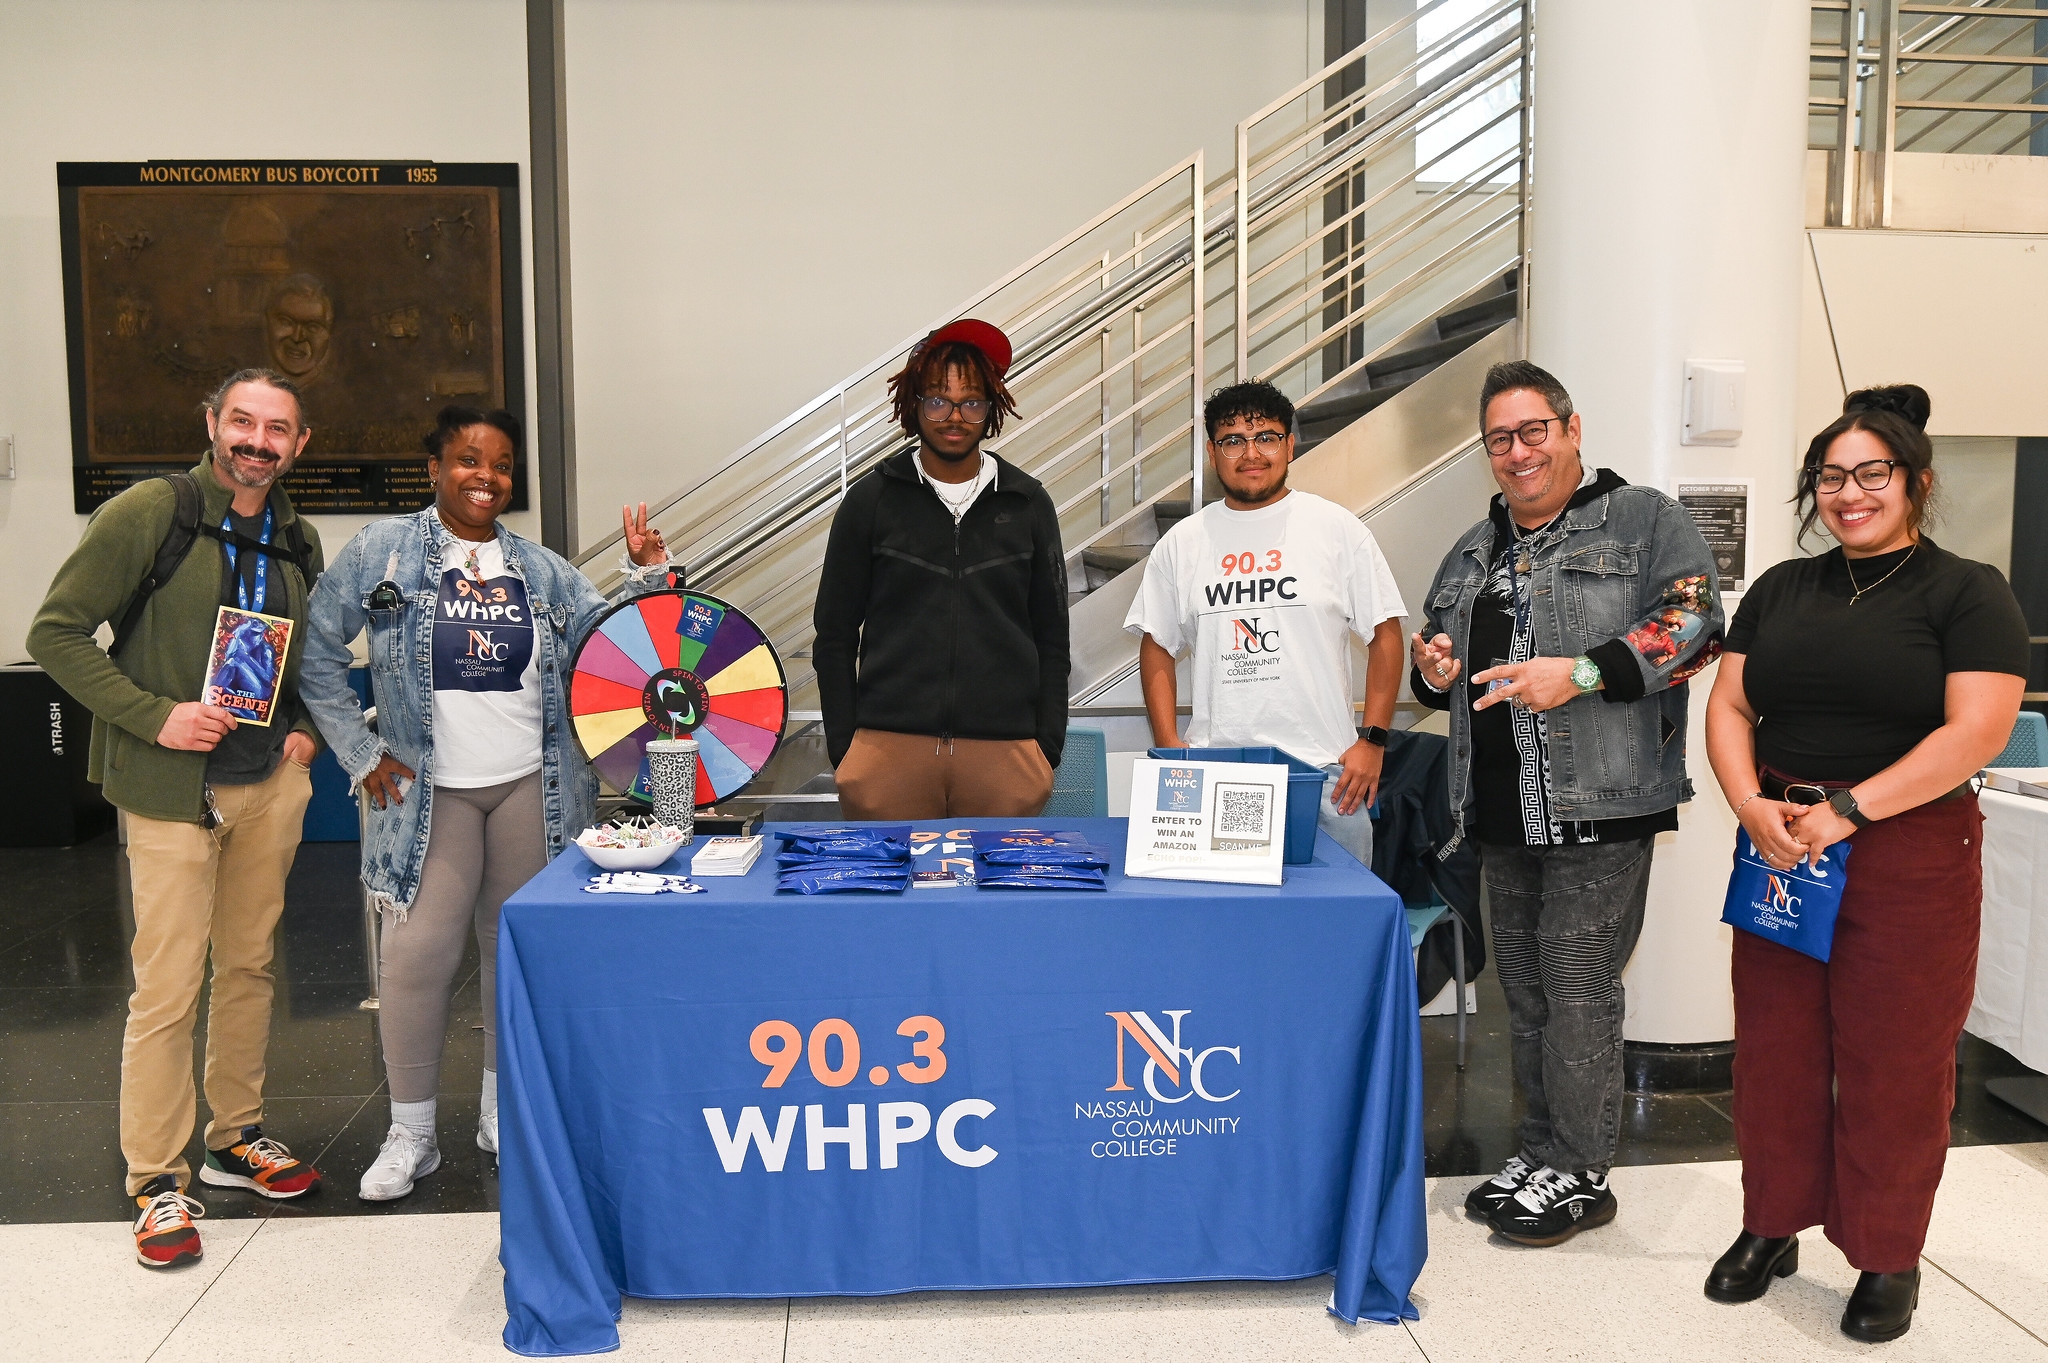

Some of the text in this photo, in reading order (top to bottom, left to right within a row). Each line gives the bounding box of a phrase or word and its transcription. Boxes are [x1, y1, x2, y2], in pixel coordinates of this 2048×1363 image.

[140, 167, 437, 183] MONTGOMERY BUS BOYCOTT 1955
[1221, 549, 1282, 577] 90.3
[1205, 576, 1298, 607] WHPC
[444, 600, 523, 622] WHPC
[687, 609, 713, 625] WHPC
[694, 604, 712, 616] 90.3
[1231, 617, 1280, 654] NCC
[466, 629, 509, 662] NCC
[455, 658, 482, 666] NASSAU
[1221, 653, 1249, 661] NASSAU
[1234, 657, 1280, 669] COMMUNITY
[461, 670, 487, 678] COLLEGE
[1227, 667, 1257, 677] COLLEGE
[208, 684, 269, 712] SCENE
[236, 689, 256, 698] THE
[672, 670, 709, 711] SPIN TO WIN
[644, 692, 652, 713] WIN
[49, 702, 63, 746] TRASH
[648, 713, 658, 725] TO
[1170, 769, 1193, 779] 90.3
[1164, 778, 1198, 789] WHPC
[1151, 816, 1202, 826] ENTER TO
[1157, 829, 1195, 838] WIN AN
[1152, 841, 1197, 851] AMAZON
[1219, 841, 1246, 851] SCAN
[1763, 873, 1802, 918] NCC
[1752, 901, 1776, 914] NASSAU
[1754, 916, 1780, 931] COLLEGE
[1761, 911, 1799, 930] COMMUNITY
[749, 1014, 947, 1089] 90.3
[1105, 1009, 1241, 1104] NCC
[1075, 1099, 1155, 1119] NASSAU
[702, 1097, 999, 1174] WHPC
[1111, 1117, 1241, 1138] COMMUNITY
[1090, 1138, 1177, 1158] COLLEGE
